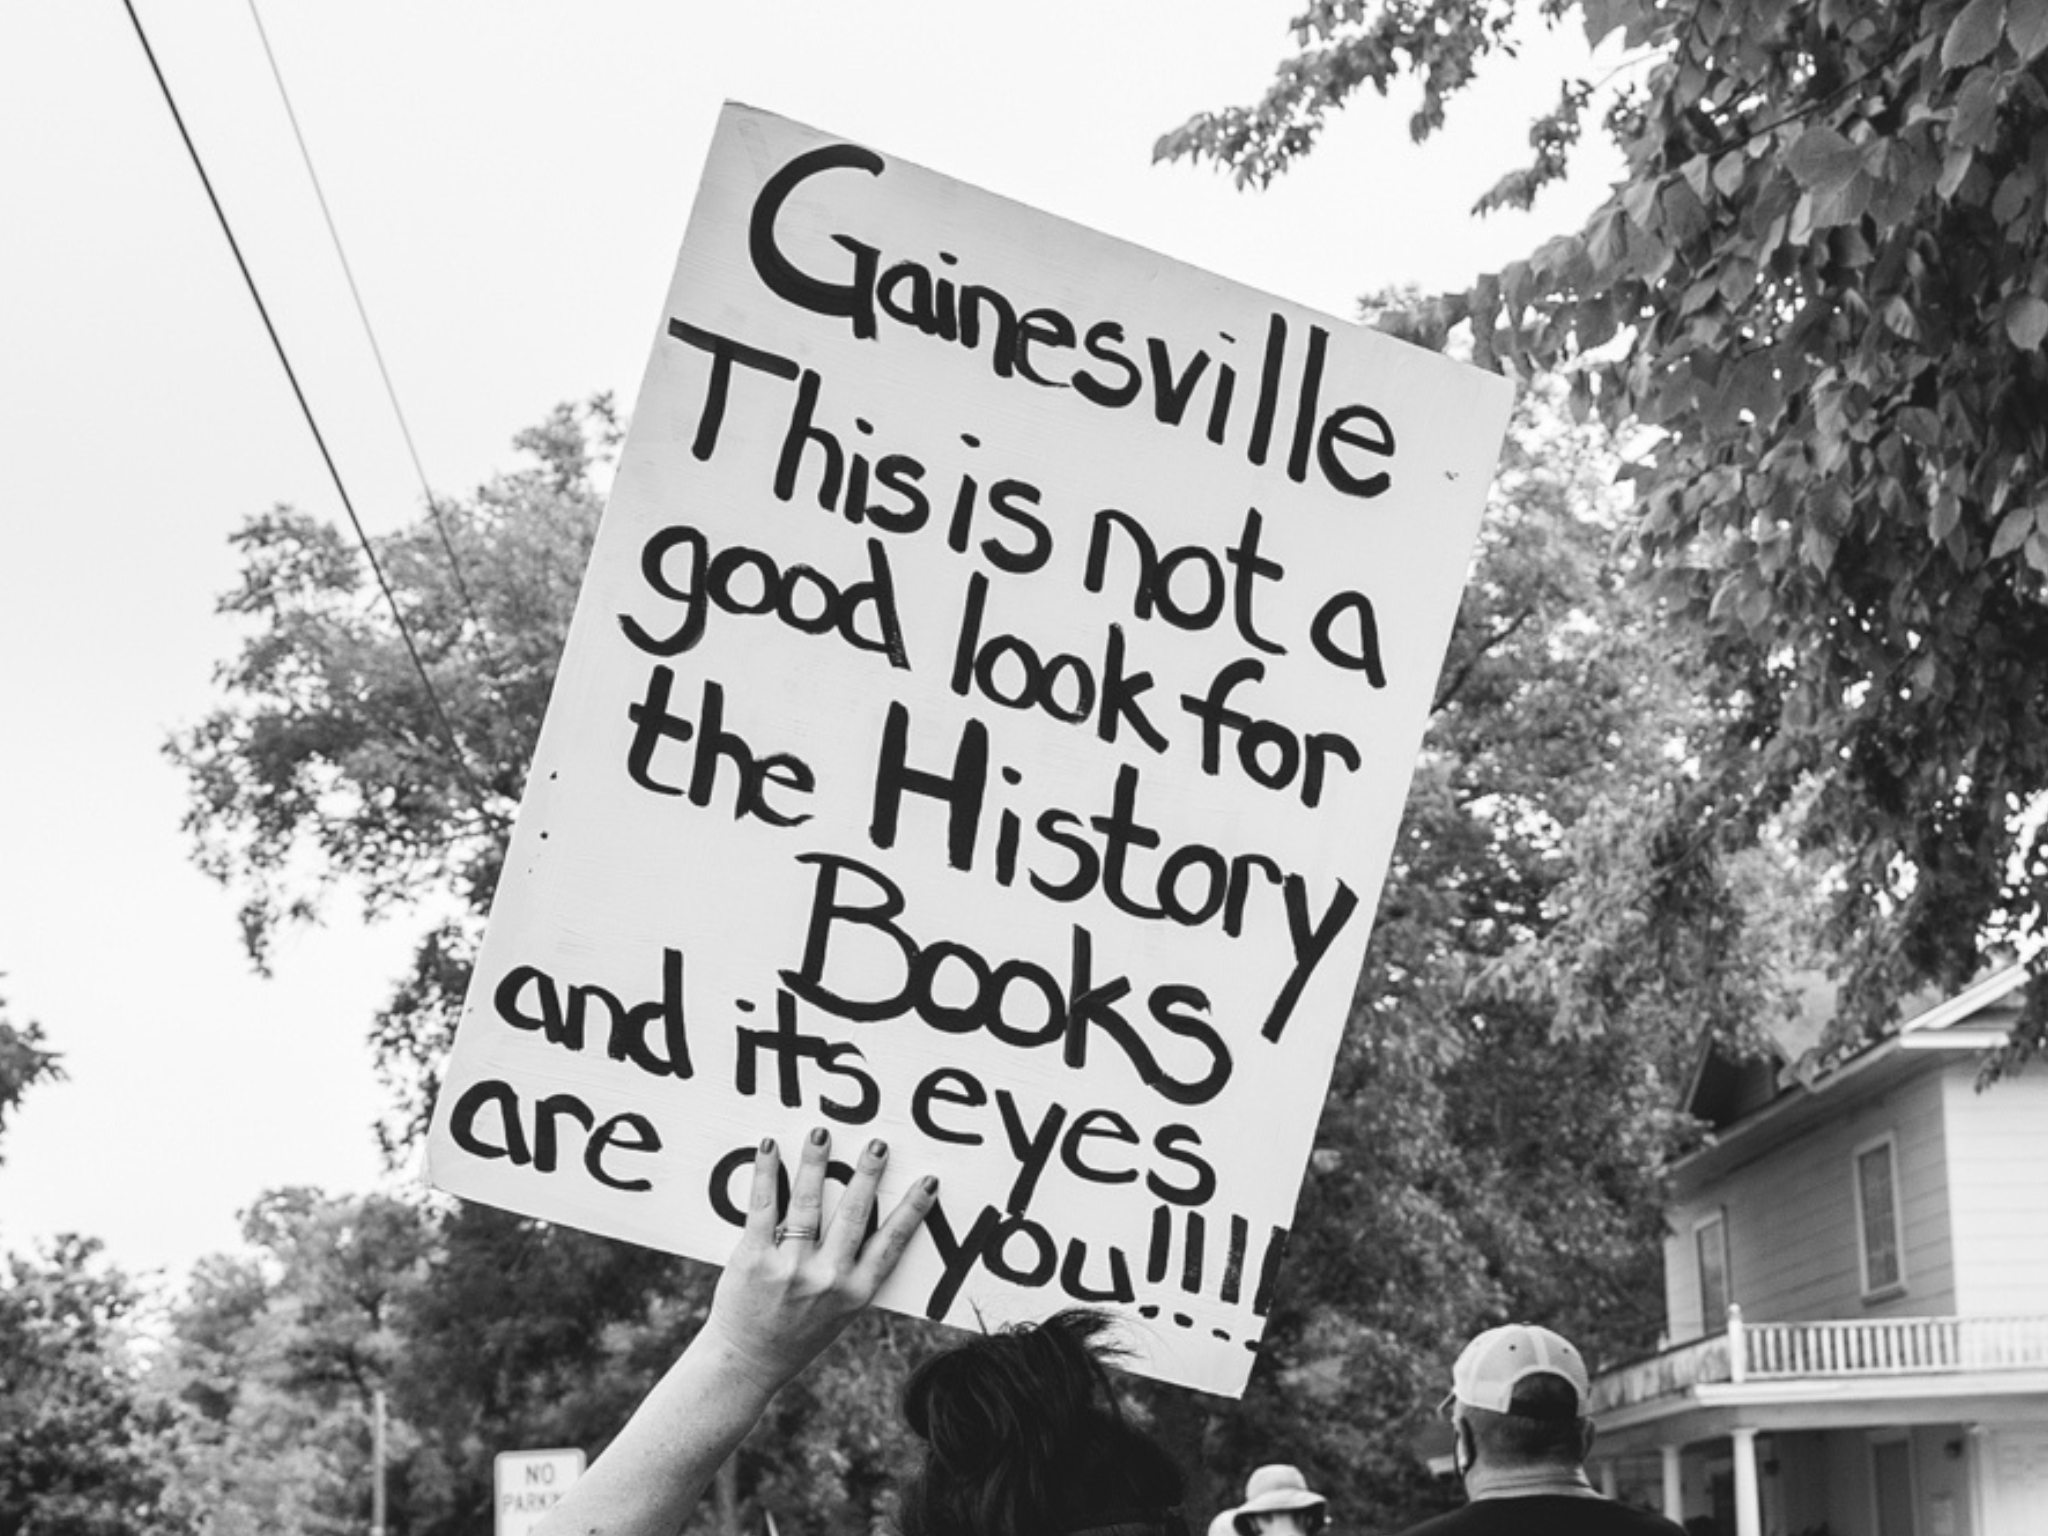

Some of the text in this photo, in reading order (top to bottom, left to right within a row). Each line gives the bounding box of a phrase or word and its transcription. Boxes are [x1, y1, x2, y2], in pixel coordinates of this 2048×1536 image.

[750, 145, 1395, 498] Gainesville
[669, 318, 1387, 689] This is not a
[619, 526, 1361, 809] good look for
[628, 665, 1359, 1044] the History
[779, 853, 1233, 1106] Books
[450, 1081, 662, 1192] are
[495, 948, 1216, 1215] and its eyes
[526, 1463, 555, 1485] NO
